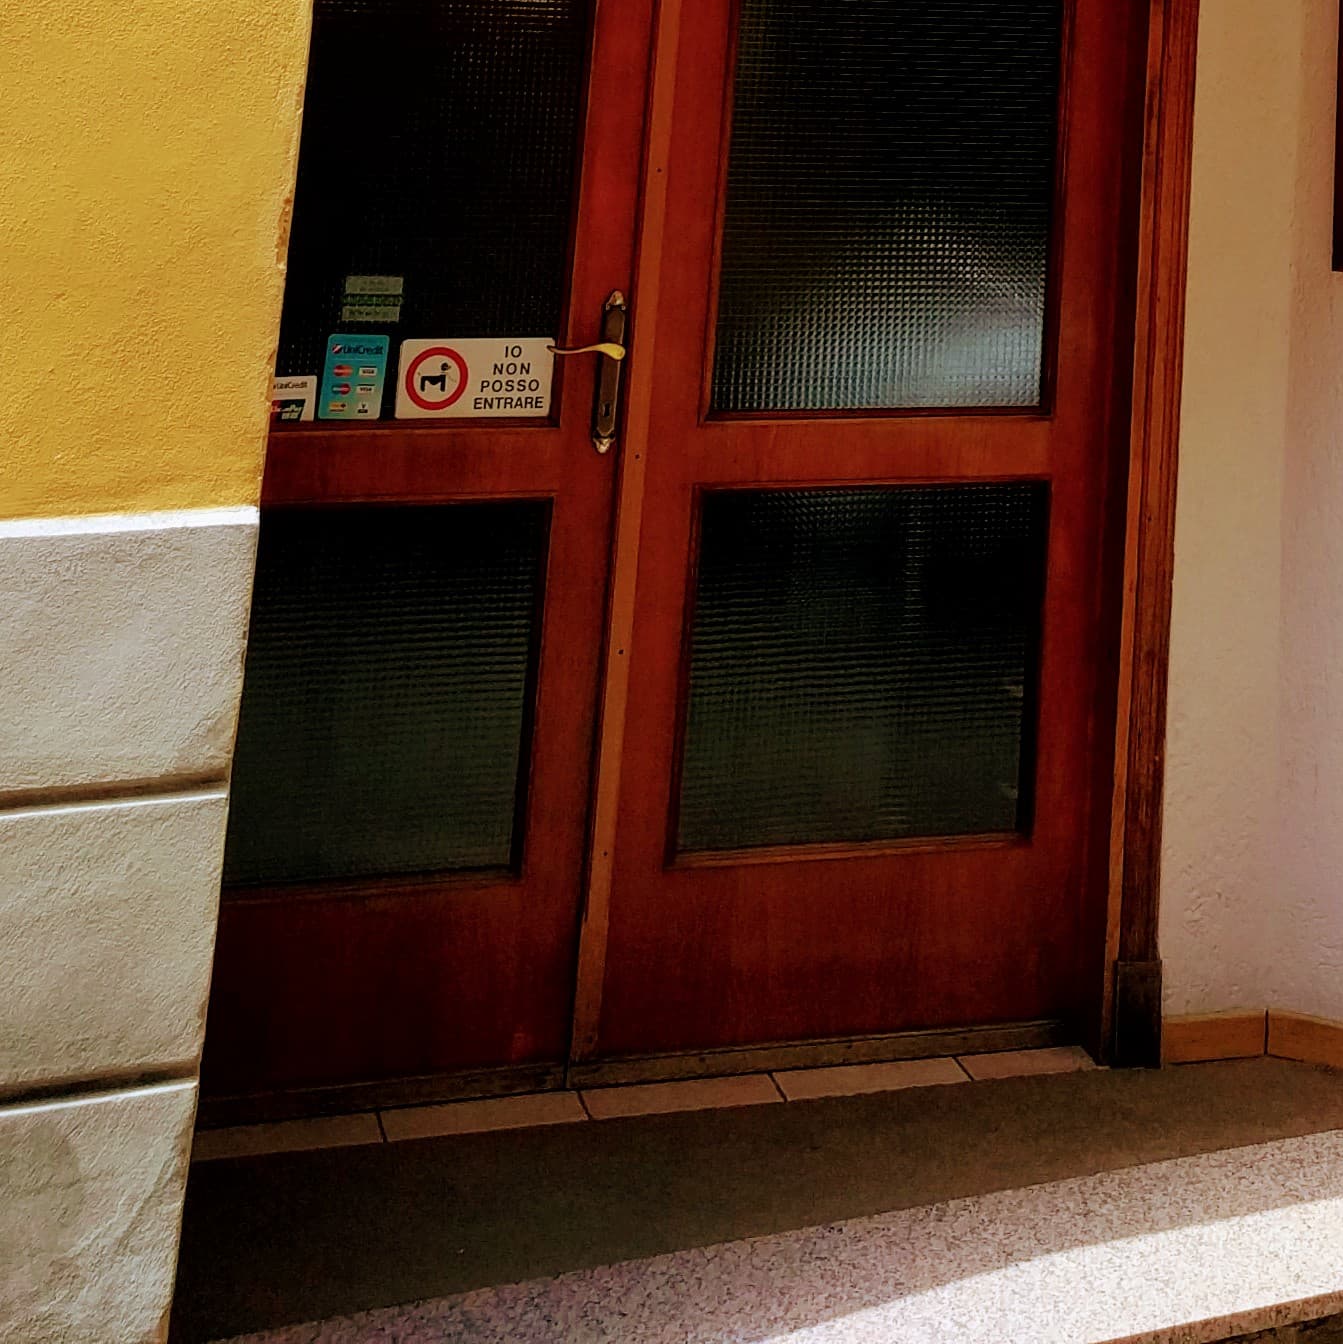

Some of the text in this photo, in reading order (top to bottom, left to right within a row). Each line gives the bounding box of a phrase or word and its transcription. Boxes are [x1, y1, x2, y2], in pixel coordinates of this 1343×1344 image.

[505, 345, 522, 358] IO
[493, 362, 531, 375] NON
[480, 379, 540, 393] POSSO
[473, 396, 545, 410] ENTRARE
